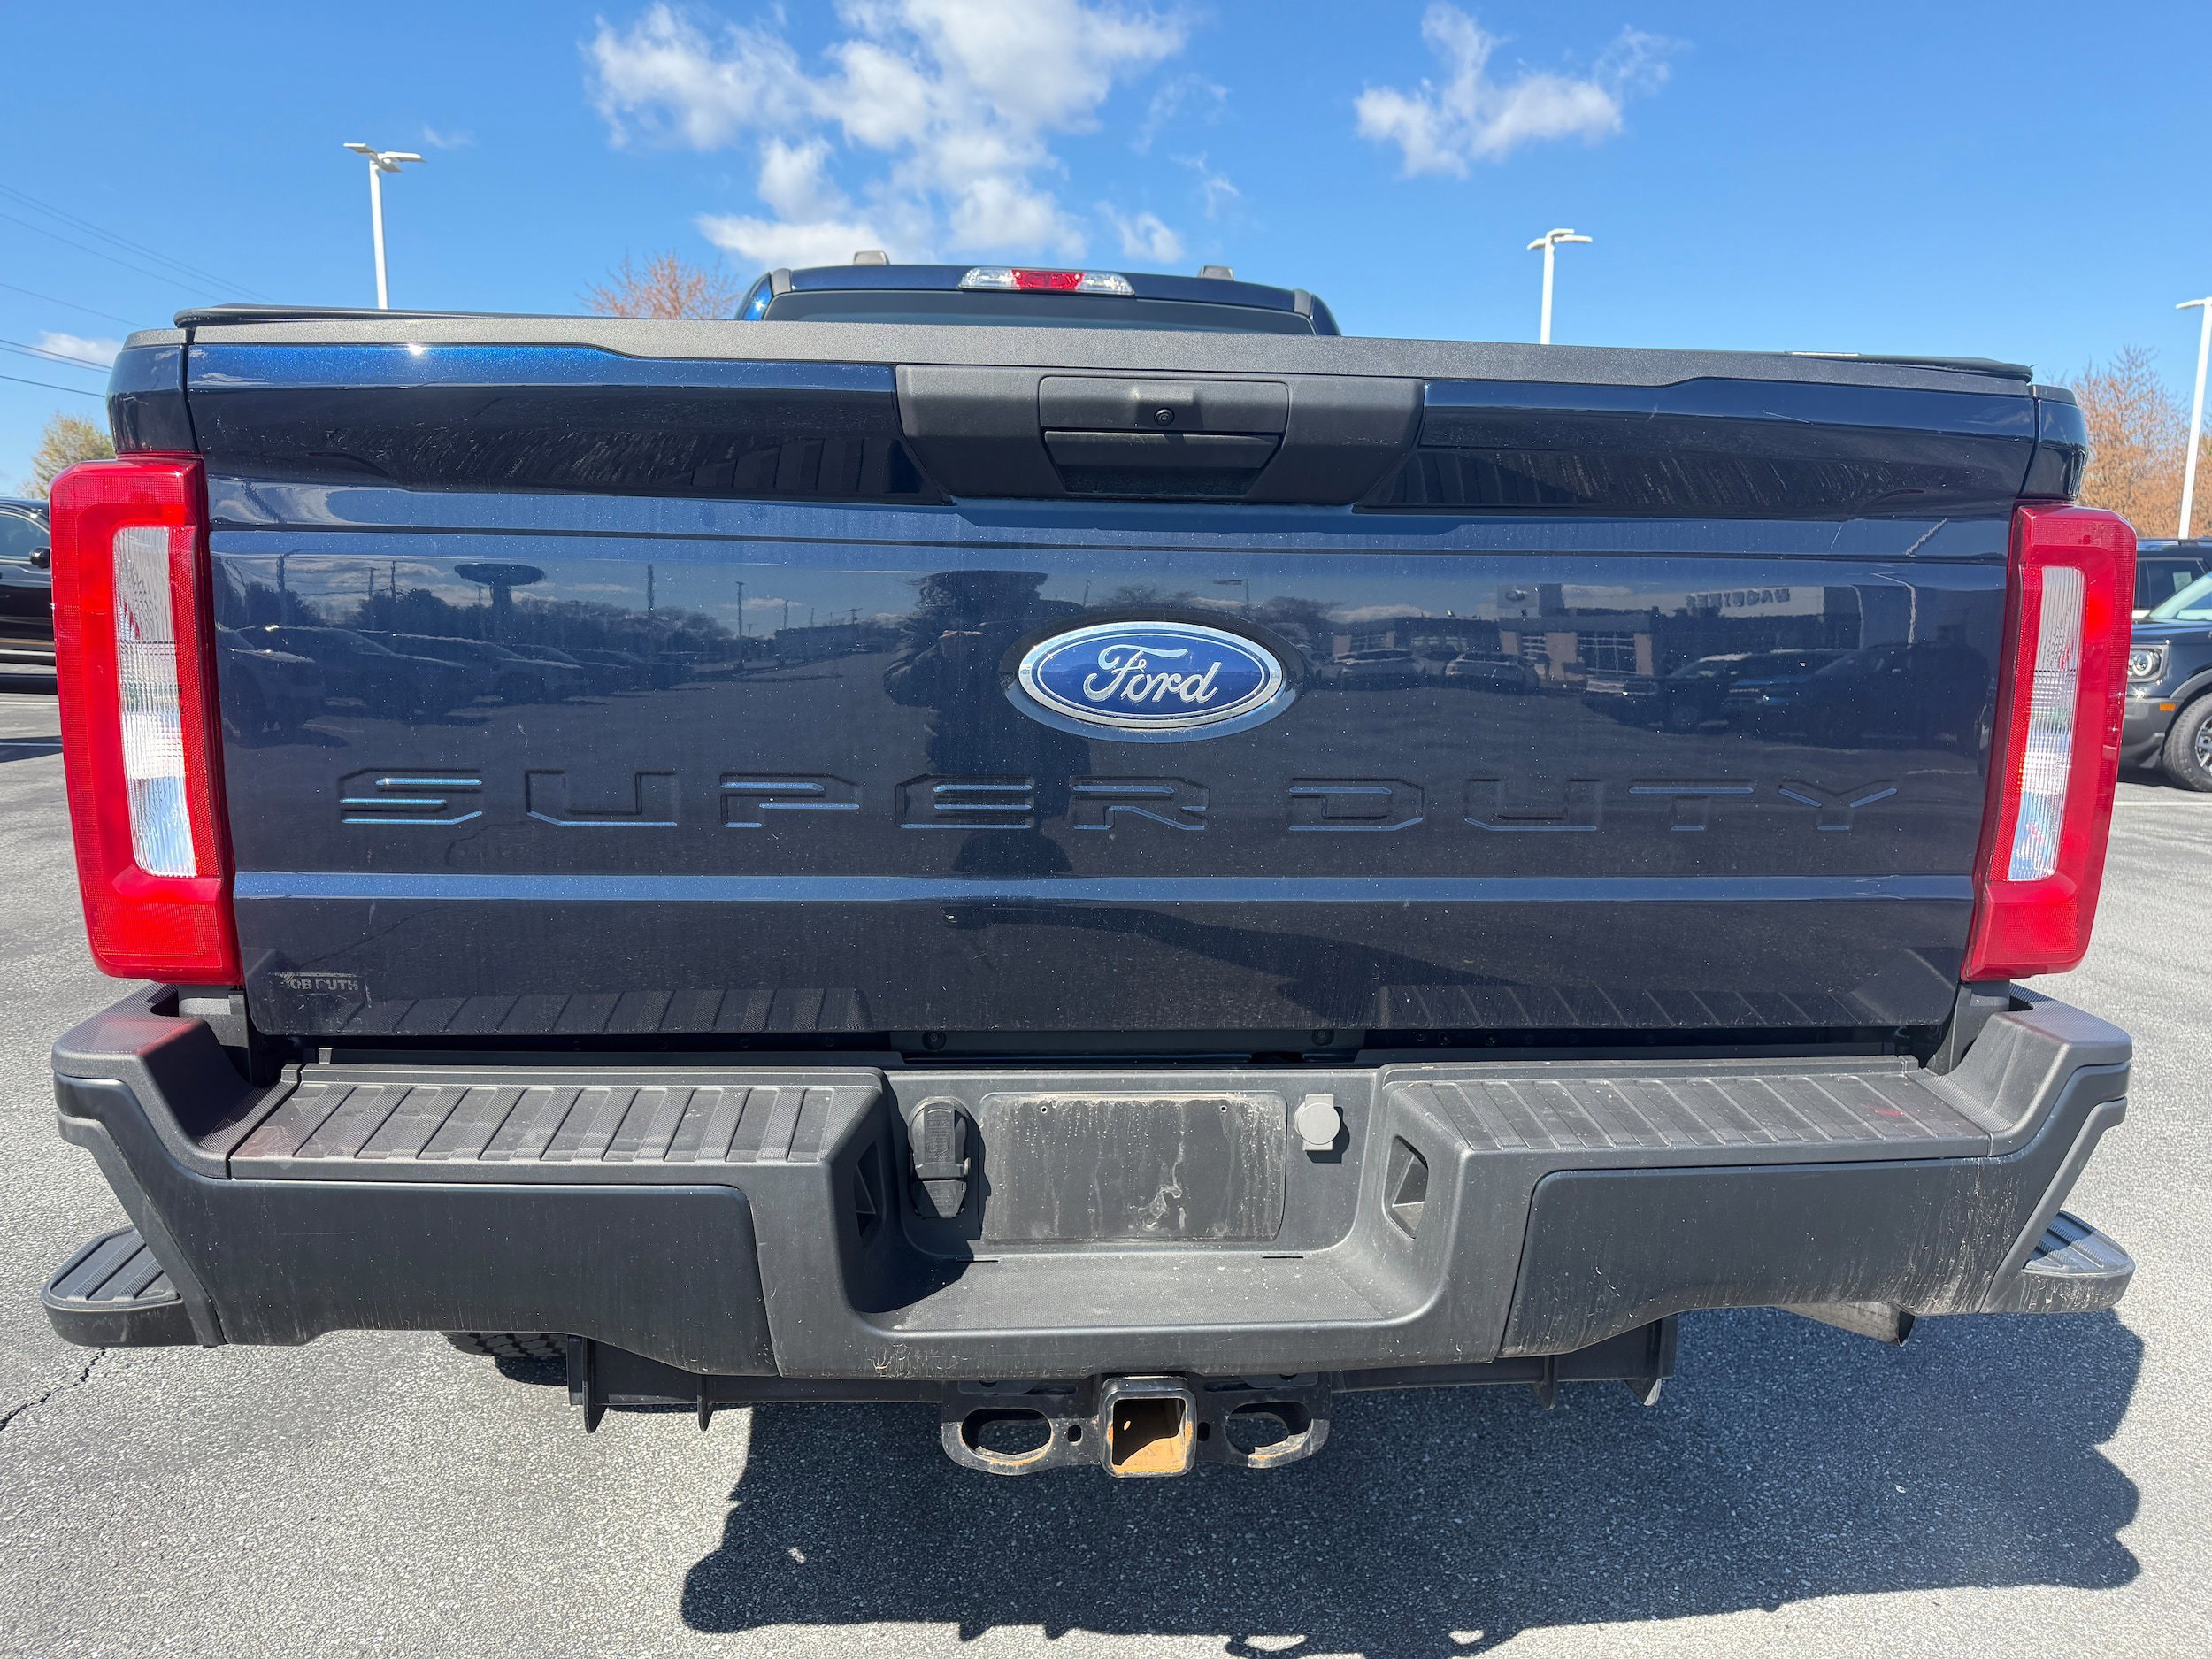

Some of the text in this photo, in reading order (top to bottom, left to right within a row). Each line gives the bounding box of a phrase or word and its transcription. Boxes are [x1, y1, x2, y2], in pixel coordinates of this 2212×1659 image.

[1082, 644, 1222, 703] Ford
[338, 768, 1899, 832] SUPER DUTY
